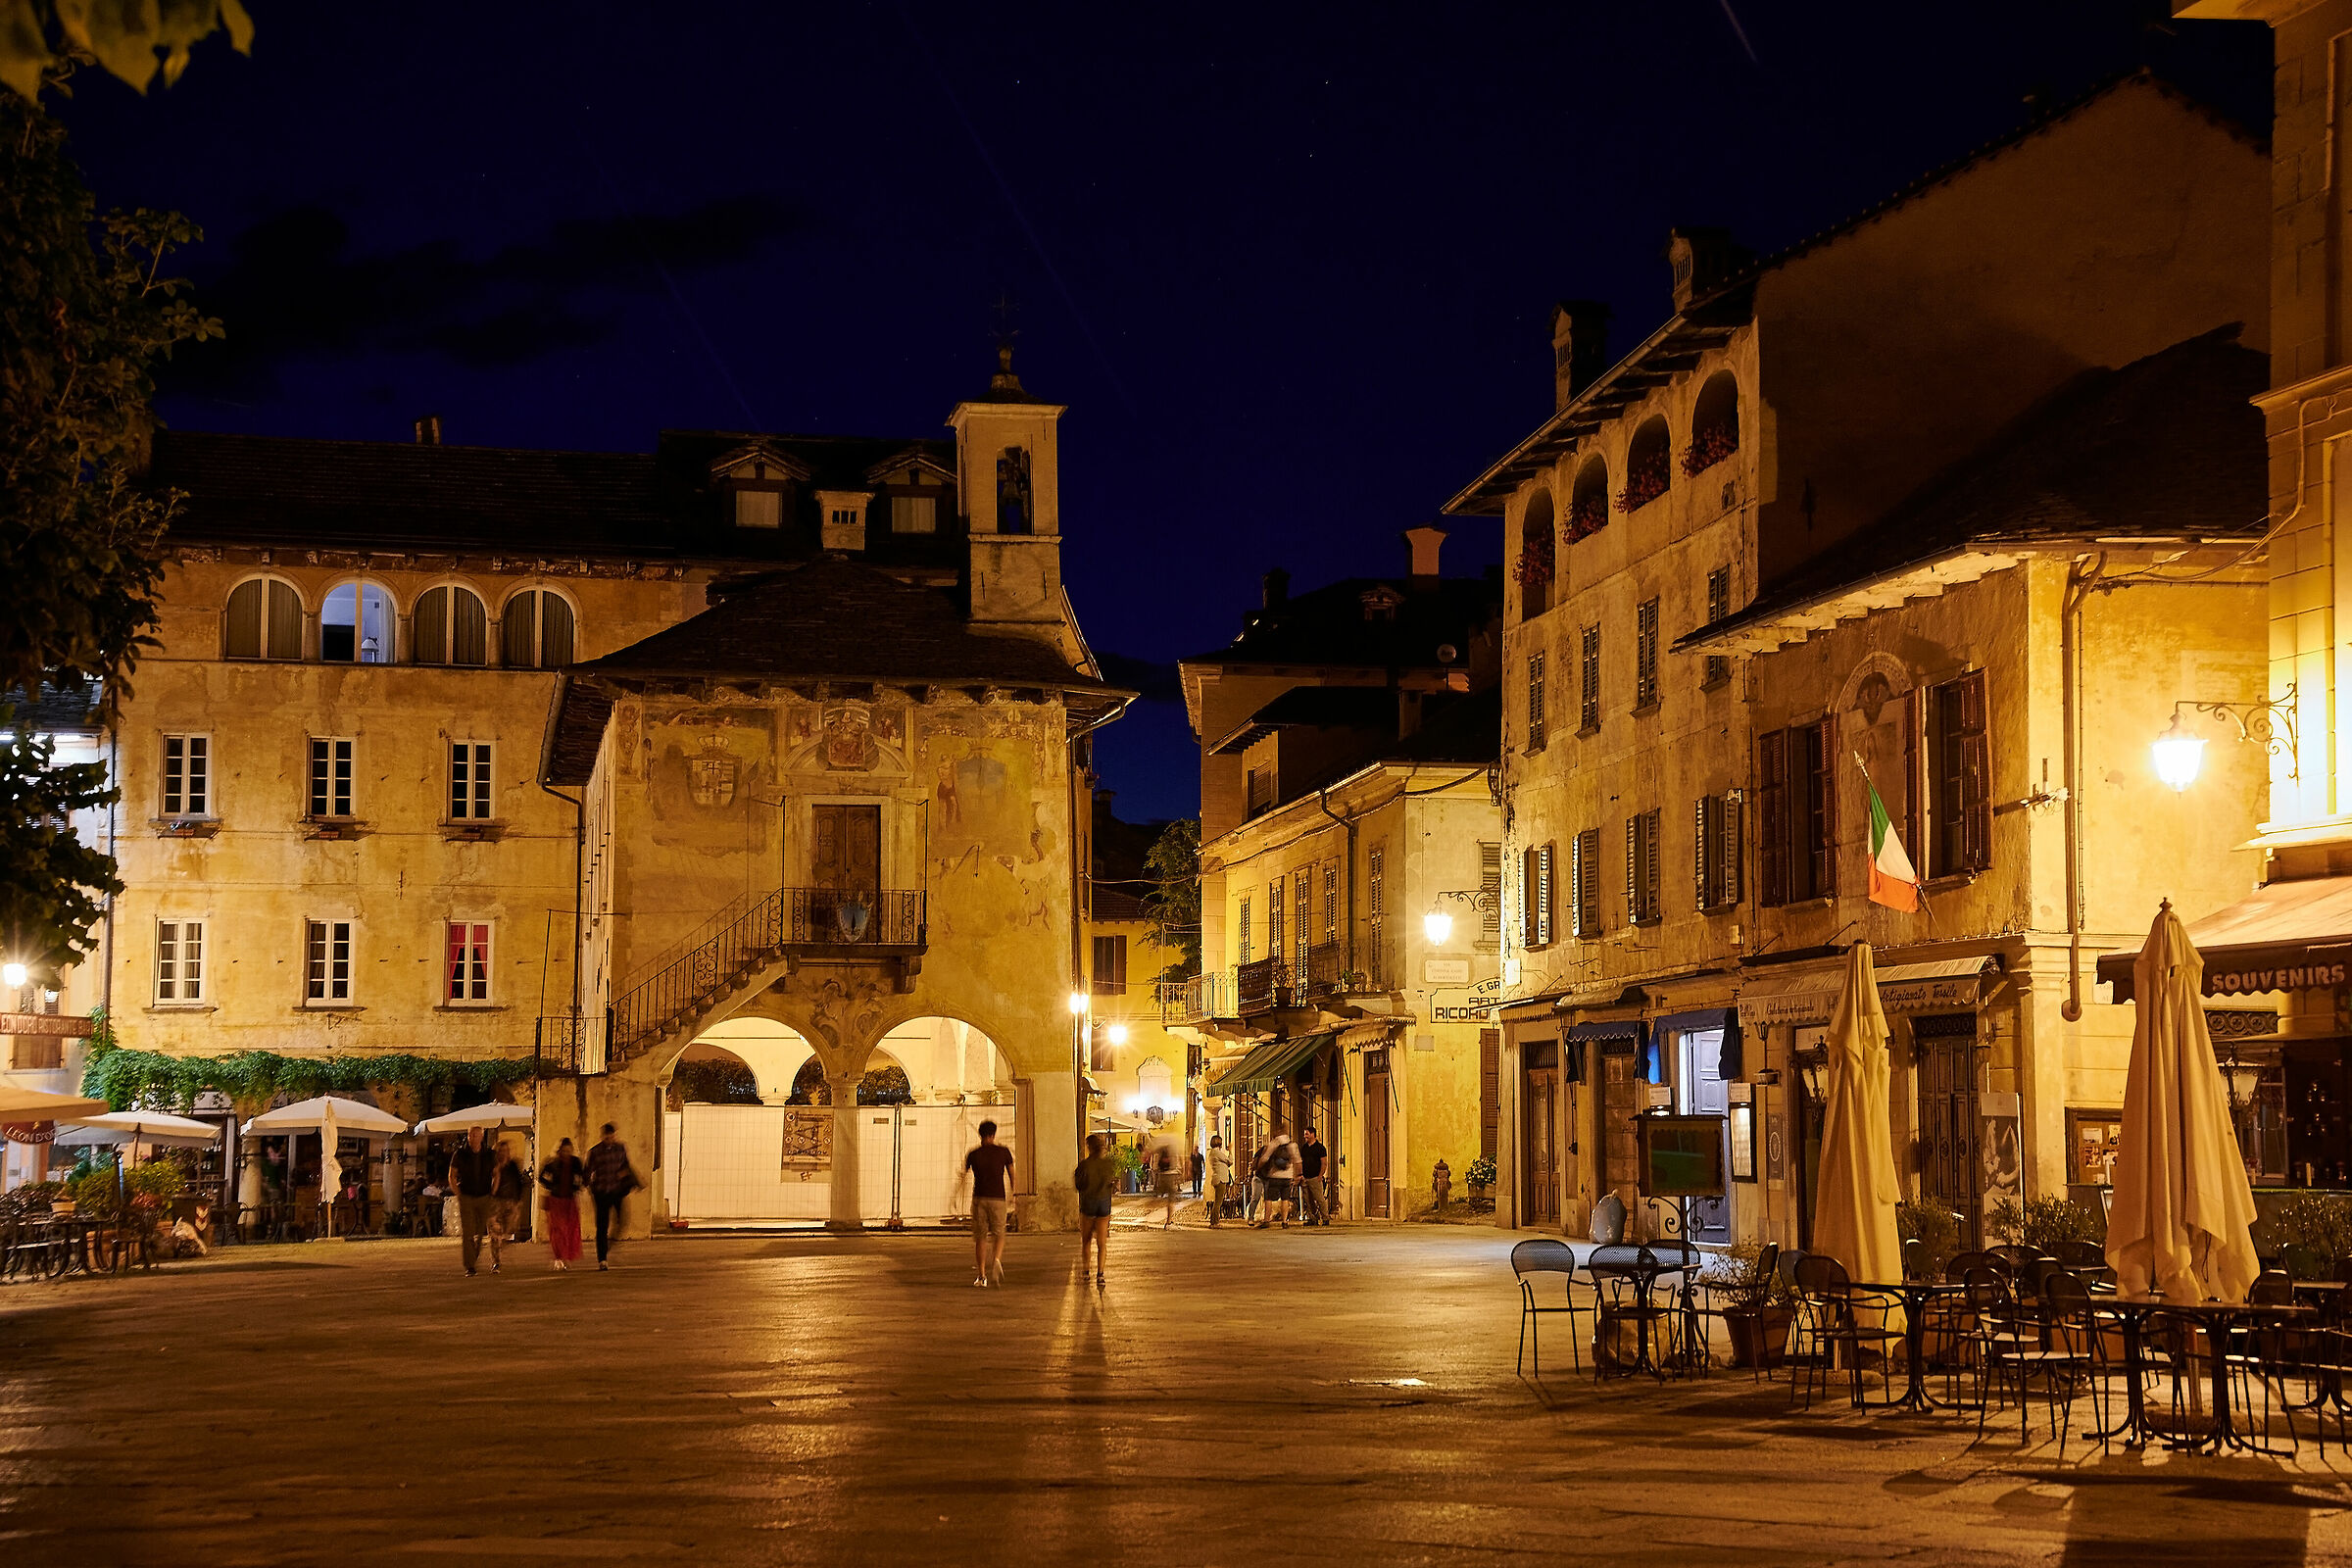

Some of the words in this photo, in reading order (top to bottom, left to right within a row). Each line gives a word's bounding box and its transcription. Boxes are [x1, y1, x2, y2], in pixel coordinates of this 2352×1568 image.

[2212, 964, 2345, 992] SOUVENIRS
[1477, 980, 1500, 995] E.GR
[1934, 983, 1957, 999] Tessile
[1469, 997, 1500, 1005] ART
[1435, 1006, 1489, 1020] RICORD
[1, 1013, 17, 1034] EON
[6, 1126, 33, 1143] LEON
[35, 1128, 56, 1143] D'OR
